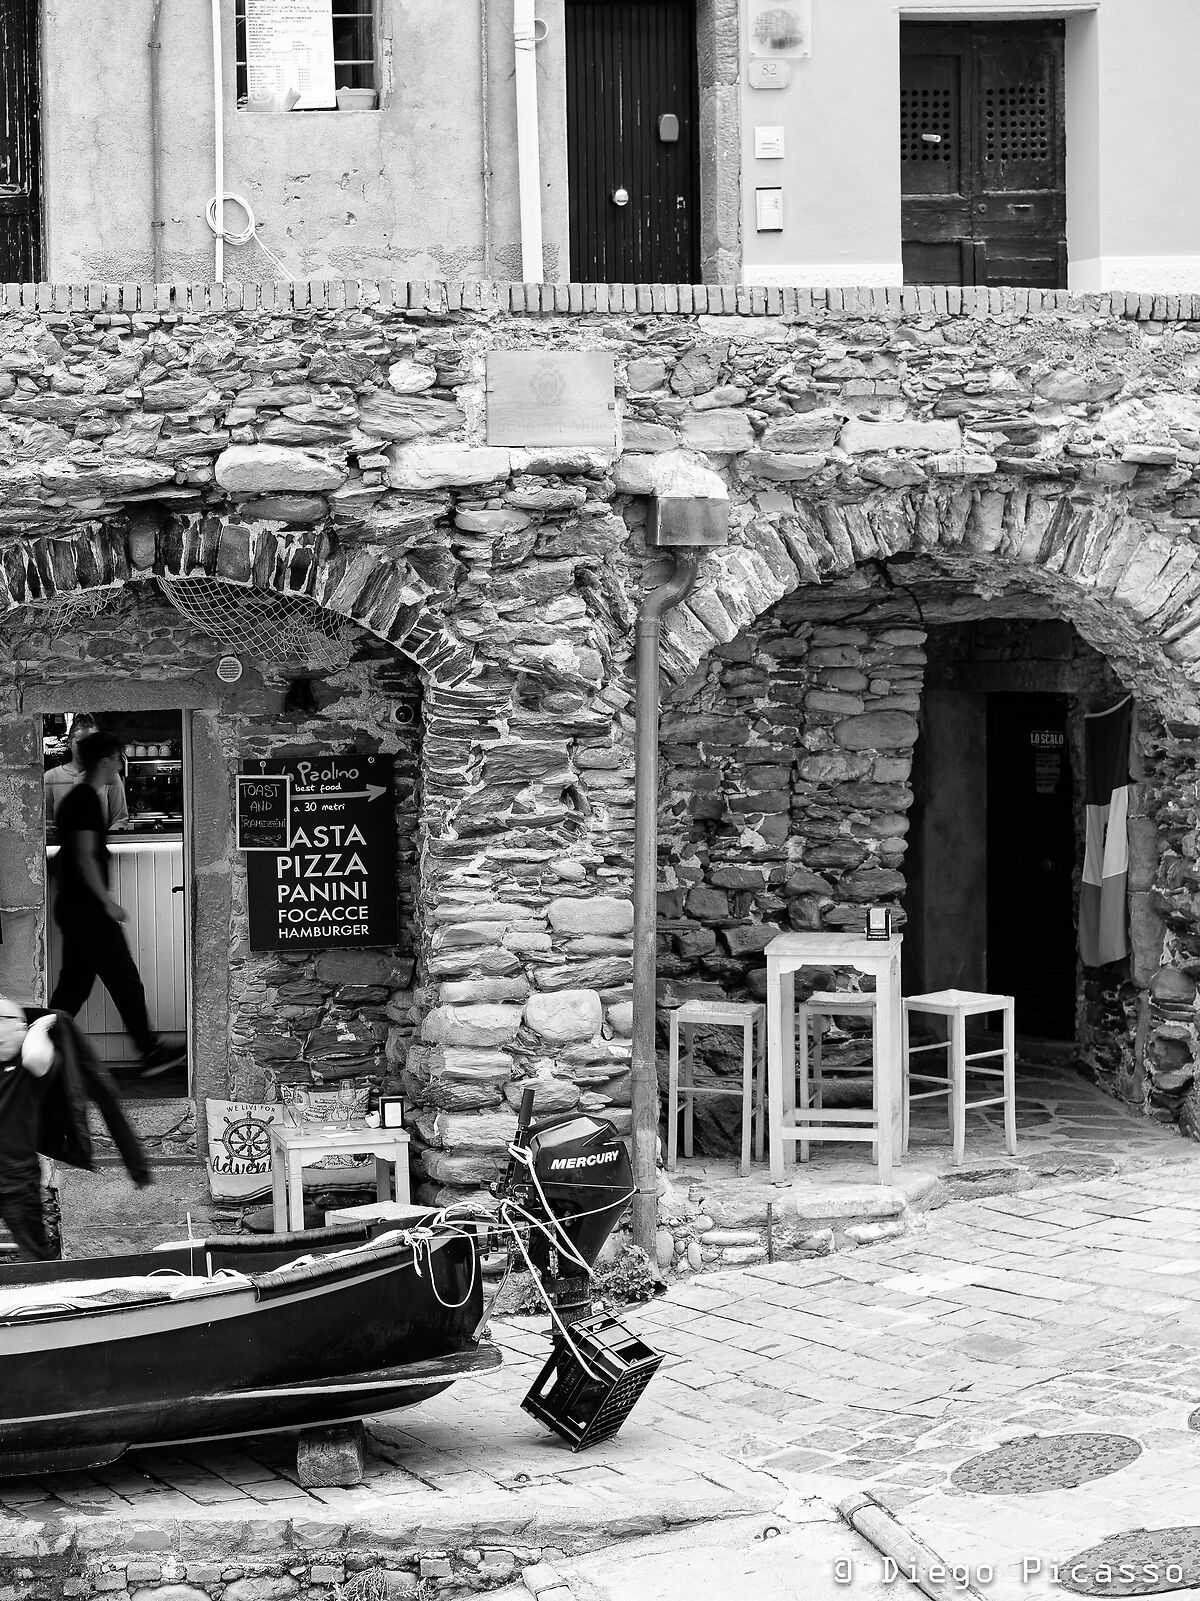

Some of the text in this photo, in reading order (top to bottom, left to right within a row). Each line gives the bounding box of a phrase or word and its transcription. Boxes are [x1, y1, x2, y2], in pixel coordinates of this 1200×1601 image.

[761, 63, 777, 76] 82
[1030, 733, 1064, 745] LO SCALO
[297, 761, 360, 786] Paolino
[239, 782, 281, 798] TOAST
[295, 783, 342, 793] best food
[250, 801, 273, 812] AND
[304, 802, 317, 812] 30
[321, 803, 346, 811] metri
[290, 824, 367, 848] ASTA
[277, 852, 369, 879] PIZZA
[277, 881, 368, 903] PANINI
[278, 906, 369, 924] FOCACCE
[278, 924, 370, 939] HAMBURGER
[260, 1105, 276, 1113] FOR
[550, 1150, 619, 1170] MERCURY
